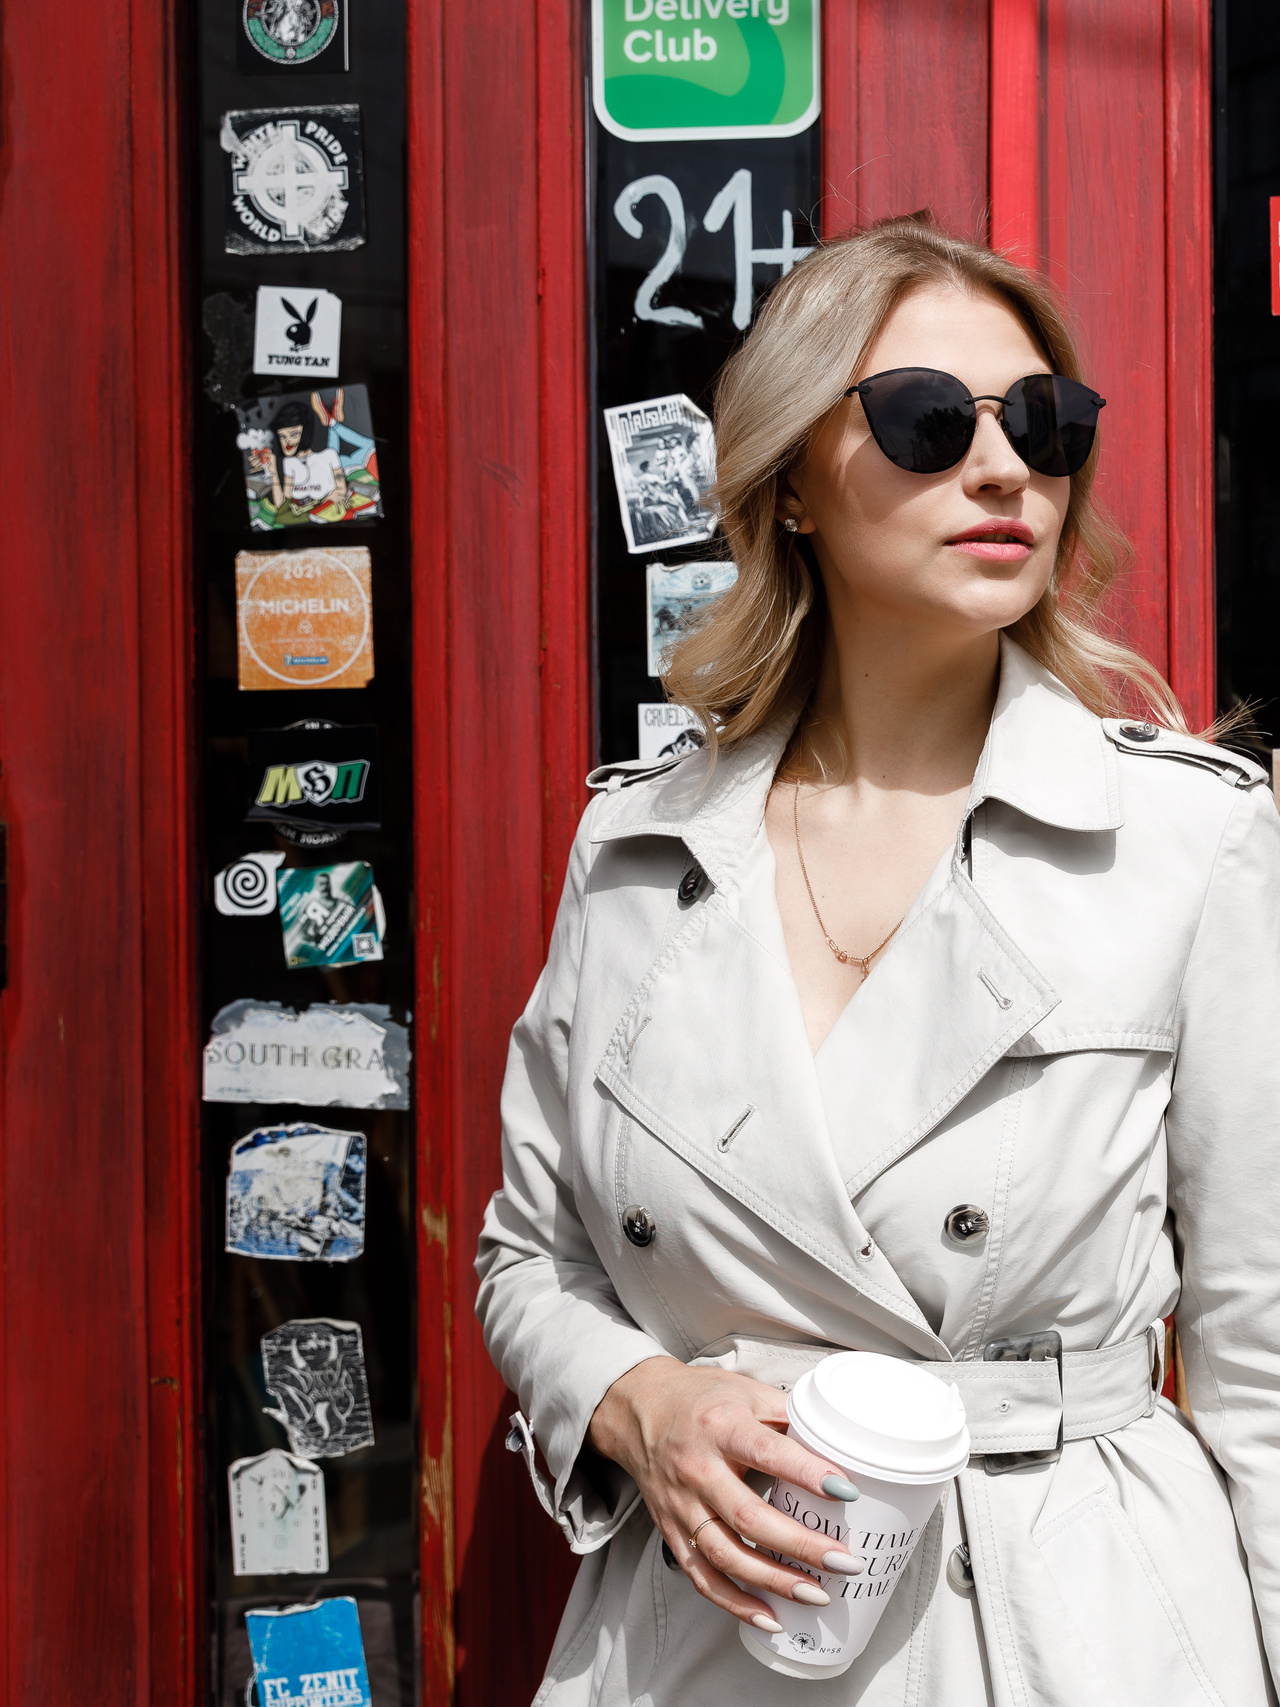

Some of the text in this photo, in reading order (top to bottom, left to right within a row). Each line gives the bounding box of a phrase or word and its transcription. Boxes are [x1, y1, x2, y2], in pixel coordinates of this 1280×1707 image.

[624, 0, 790, 26] Delivery
[623, 28, 718, 64] Club
[304, 120, 349, 165] PRIDE
[231, 195, 282, 243] WORLD
[613, 168, 816, 330] 21+
[283, 564, 322, 580] 2021
[260, 598, 351, 614] MICHELIN
[208, 1040, 310, 1068] SOUTH
[783, 1491, 919, 1551] SLOW TIME
[838, 1576, 895, 1599] TIME
[262, 1668, 360, 1700] FC ZENIT
